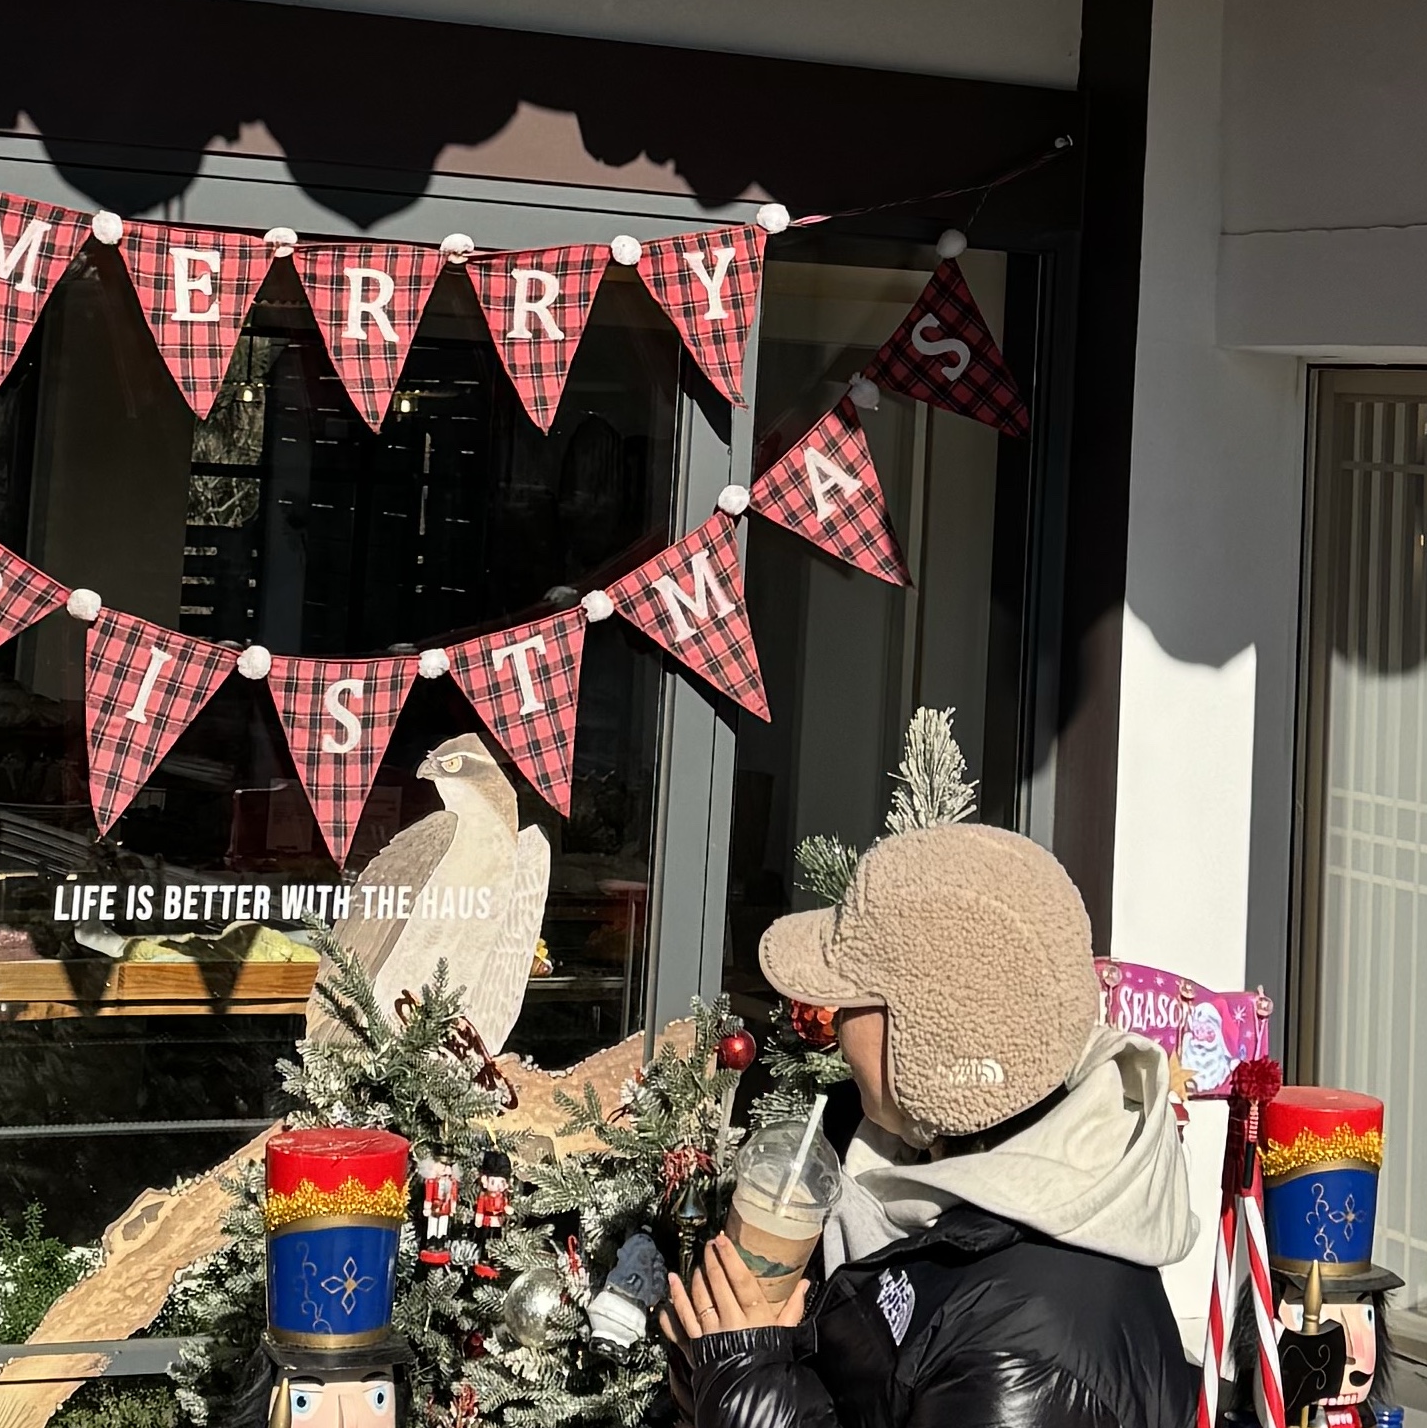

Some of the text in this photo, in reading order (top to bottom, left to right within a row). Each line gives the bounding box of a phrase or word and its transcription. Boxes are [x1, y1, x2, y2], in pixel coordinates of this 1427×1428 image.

[53, 884, 492, 921] LIFE IS BETTER WITH THE HAUS
